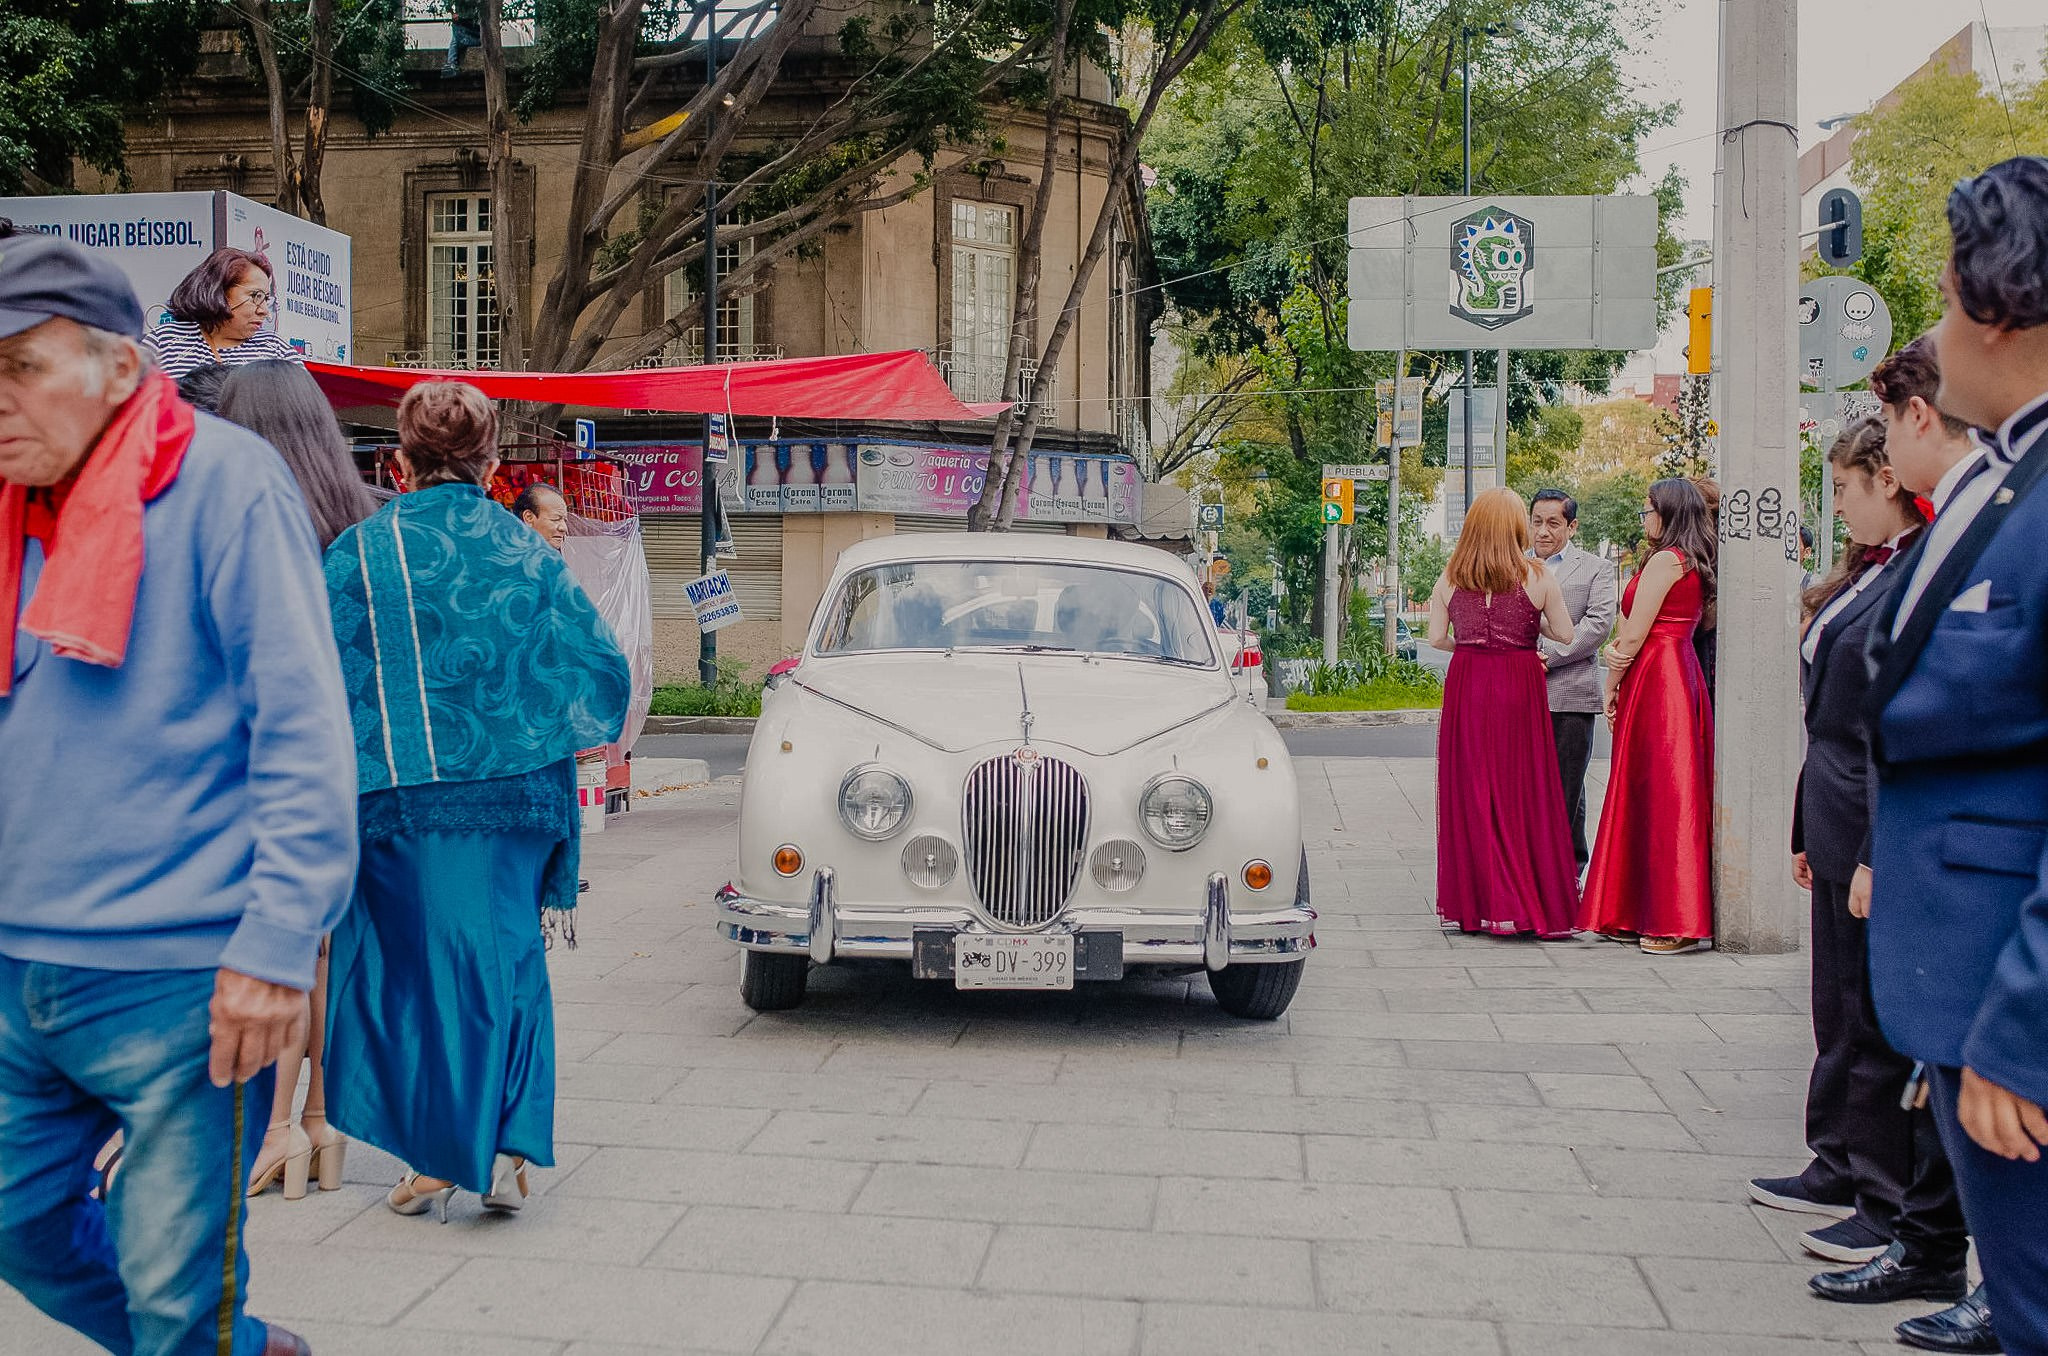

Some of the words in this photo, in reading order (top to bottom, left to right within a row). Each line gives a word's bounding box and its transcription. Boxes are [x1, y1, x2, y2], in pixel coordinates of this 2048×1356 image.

[69, 222, 120, 247] JUGAR
[125, 217, 202, 248] BÉISBOL,
[286, 241, 306, 270] ESTÁ
[307, 248, 331, 277] CHIDO
[287, 269, 315, 300] JUGAR
[920, 451, 970, 469] Taqueria
[879, 469, 937, 491] PUNTO
[1335, 467, 1376, 477] PUEBLA
[748, 487, 780, 501] Corona
[783, 486, 816, 498] Corona
[820, 486, 852, 498] Corona
[685, 573, 732, 605] MARIACHI
[997, 938, 1029, 946] CDMX
